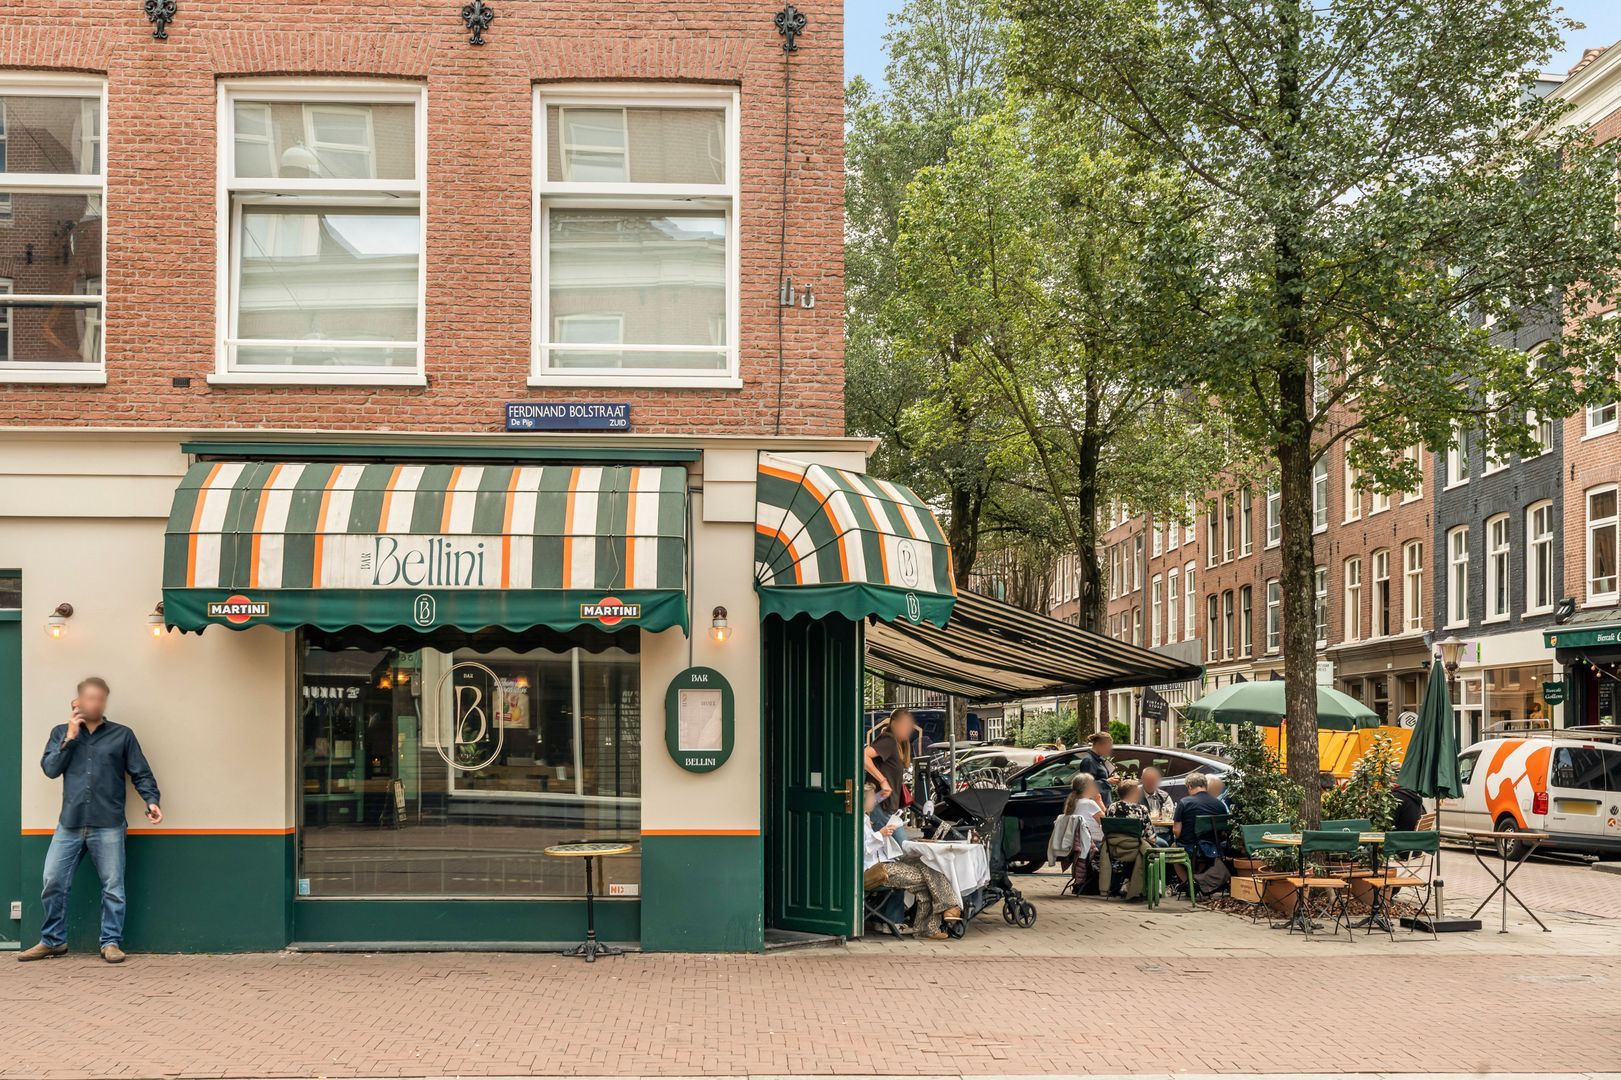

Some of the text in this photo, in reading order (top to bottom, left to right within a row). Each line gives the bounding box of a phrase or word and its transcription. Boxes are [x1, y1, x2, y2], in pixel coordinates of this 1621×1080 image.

[508, 405, 626, 418] FERDINAND BOLSTRAAT
[511, 418, 521, 426] De
[609, 418, 627, 427] ZUID
[360, 552, 372, 570] BAR
[372, 536, 485, 587] Bellini
[211, 604, 266, 614] MARTINI
[419, 601, 430, 620] B
[583, 606, 637, 616] MARTINI
[691, 673, 708, 682] BAR
[455, 685, 487, 744] B
[685, 758, 716, 767] BELLINI
